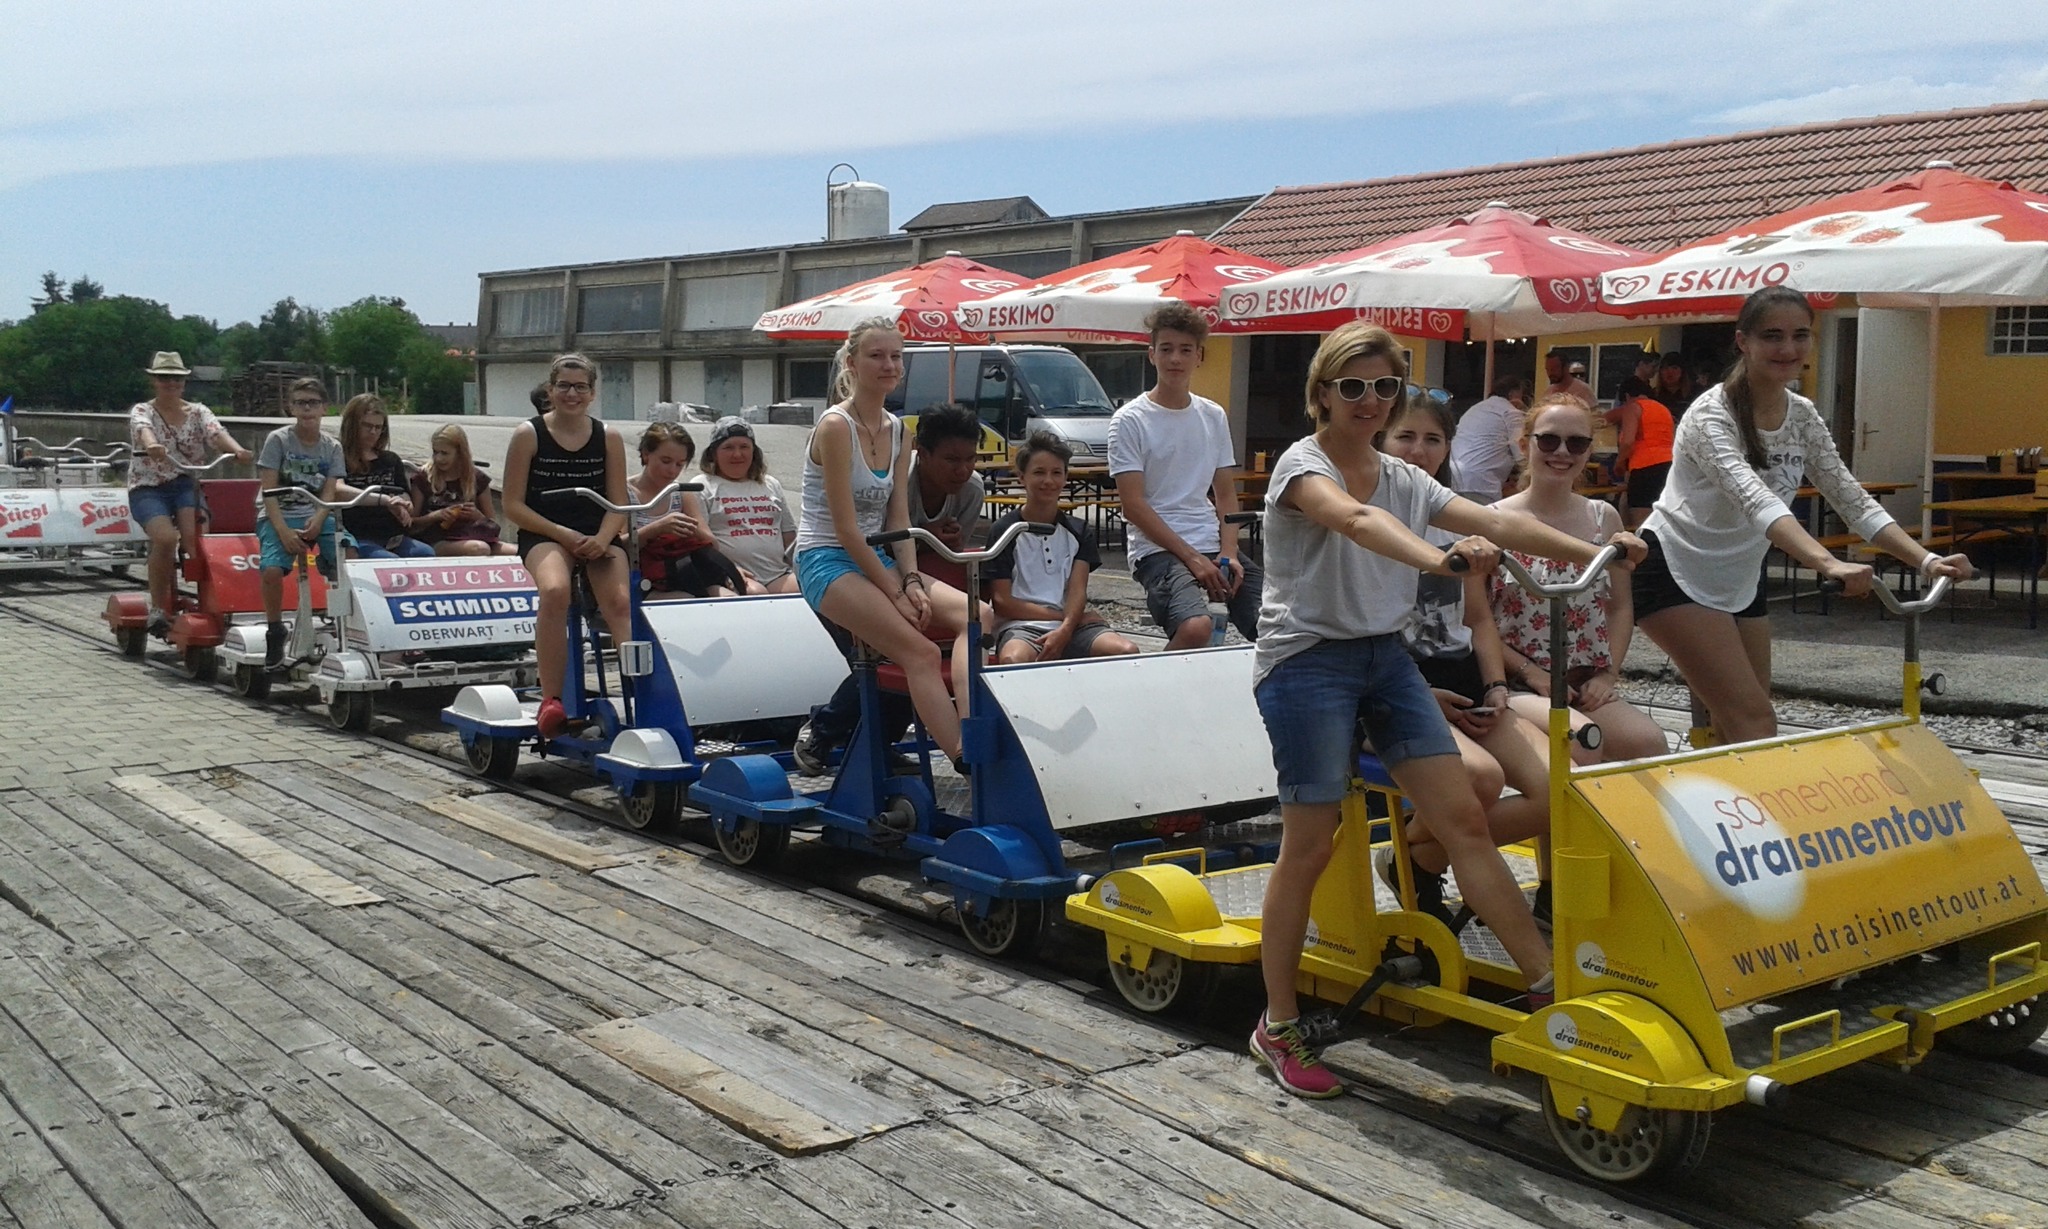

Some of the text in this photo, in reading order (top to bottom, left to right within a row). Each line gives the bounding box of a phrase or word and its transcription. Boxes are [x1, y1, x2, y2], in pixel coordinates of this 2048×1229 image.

[1657, 261, 1790, 295] ESKIMO
[1265, 282, 1348, 313] ESKIMO
[777, 310, 822, 328] ESKIMO
[988, 303, 1055, 327] ESKIMO
[80, 502, 130, 527] Stieg
[230, 554, 261, 571] SC
[390, 568, 527, 588] DRUCKE
[409, 625, 494, 641] OBERWART
[1714, 766, 1910, 830] sonnenland
[1715, 800, 1968, 887] draisinentour
[1732, 874, 2023, 977] www.draisinentour.at
[1304, 935, 1356, 956] raisinentour
[1582, 957, 1659, 989] draisinentour
[1555, 1028, 1633, 1061] draisinentour
